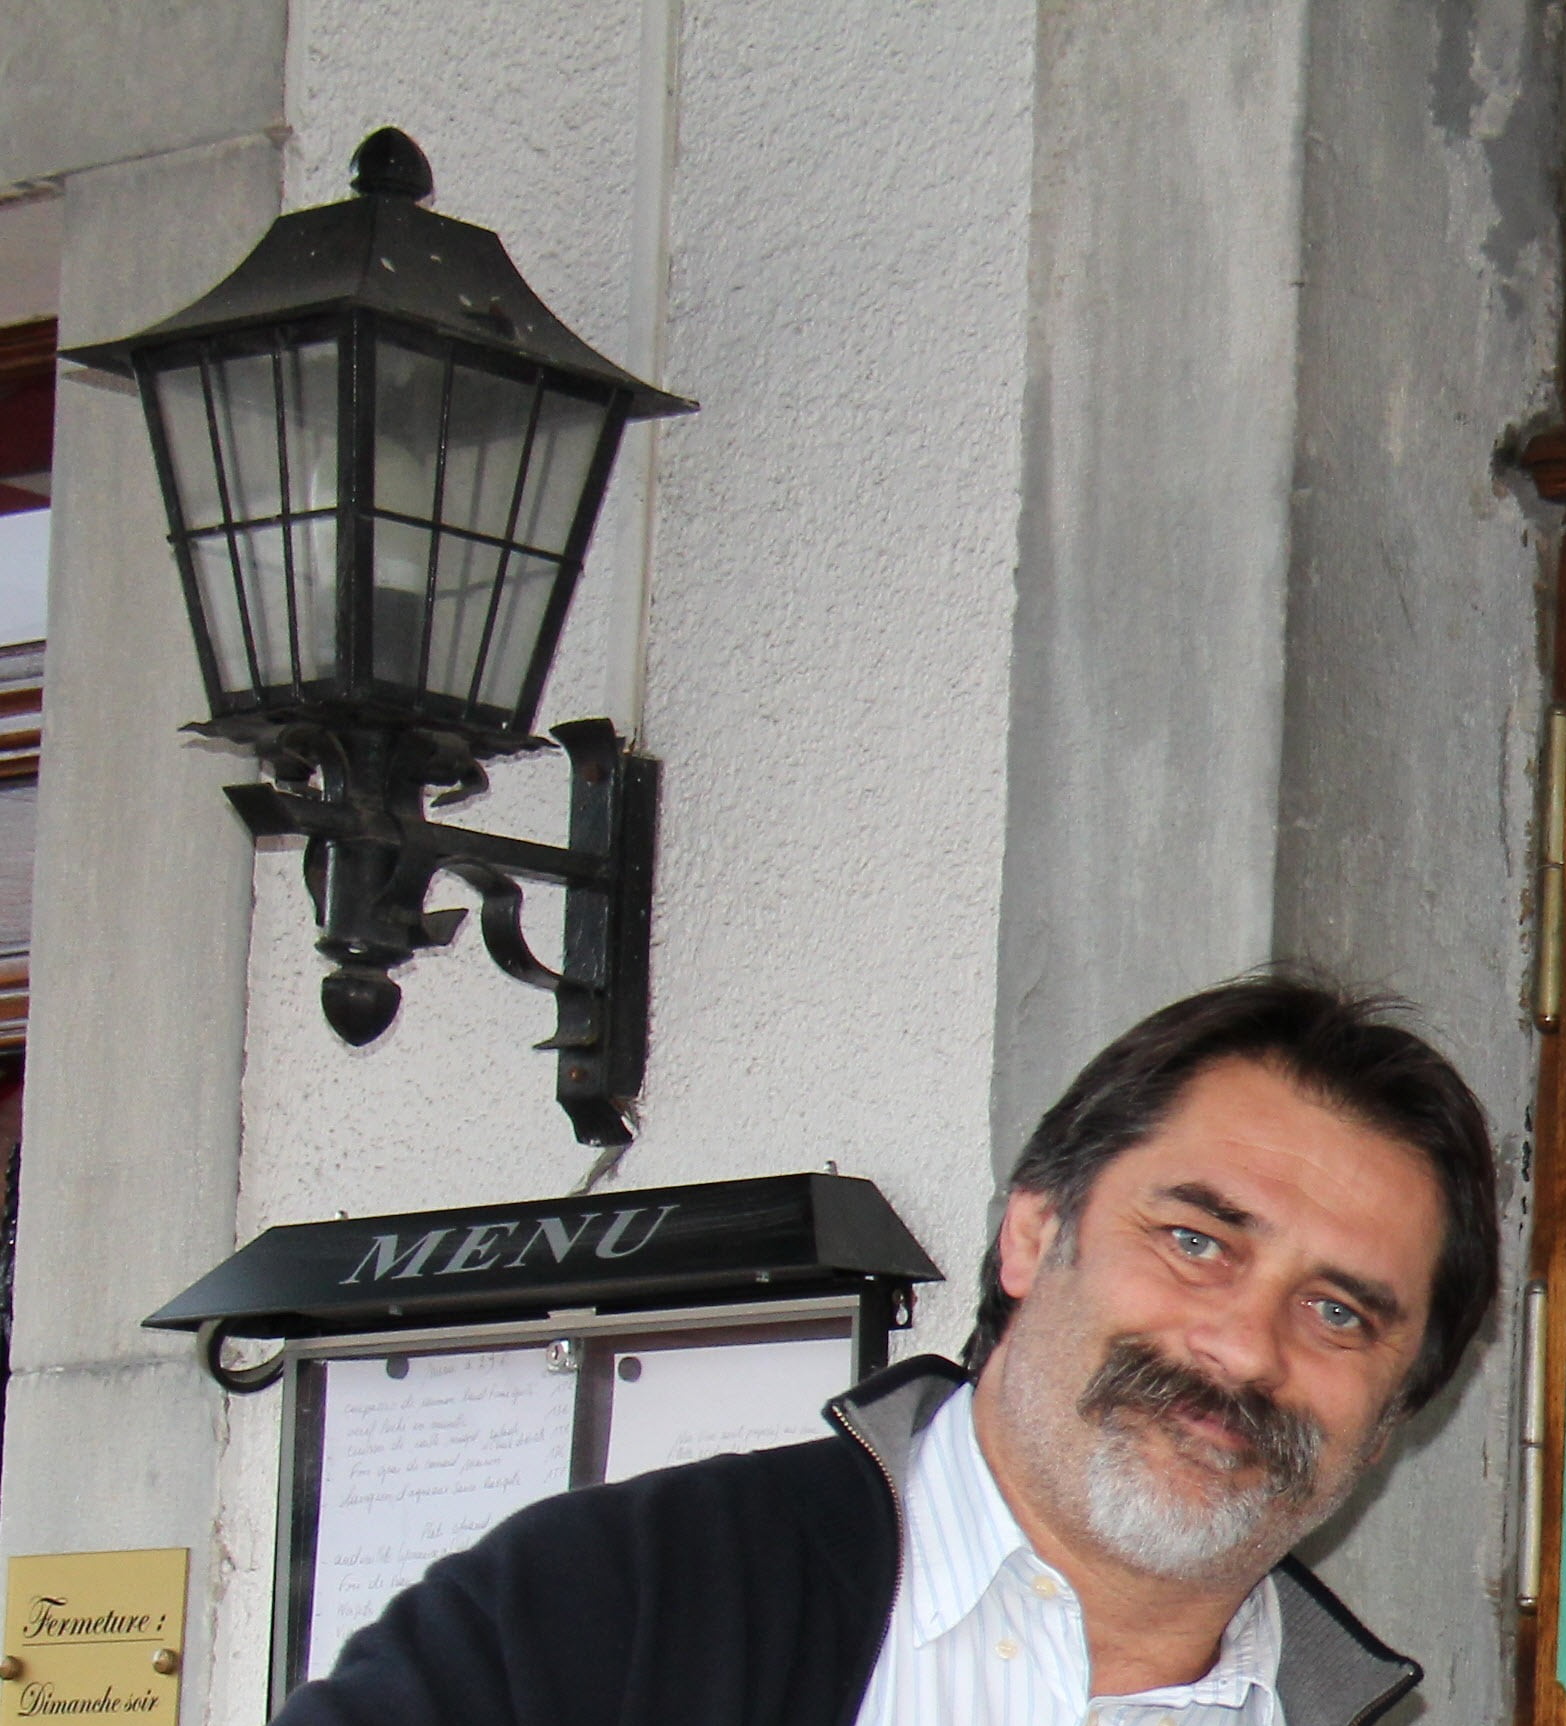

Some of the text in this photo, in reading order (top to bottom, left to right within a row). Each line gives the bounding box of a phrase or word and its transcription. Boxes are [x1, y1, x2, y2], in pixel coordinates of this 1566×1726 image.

[338, 1203, 681, 1286] MENU
[23, 1596, 151, 1639] Fermeture
[18, 1681, 160, 1717] Dimanche soir
